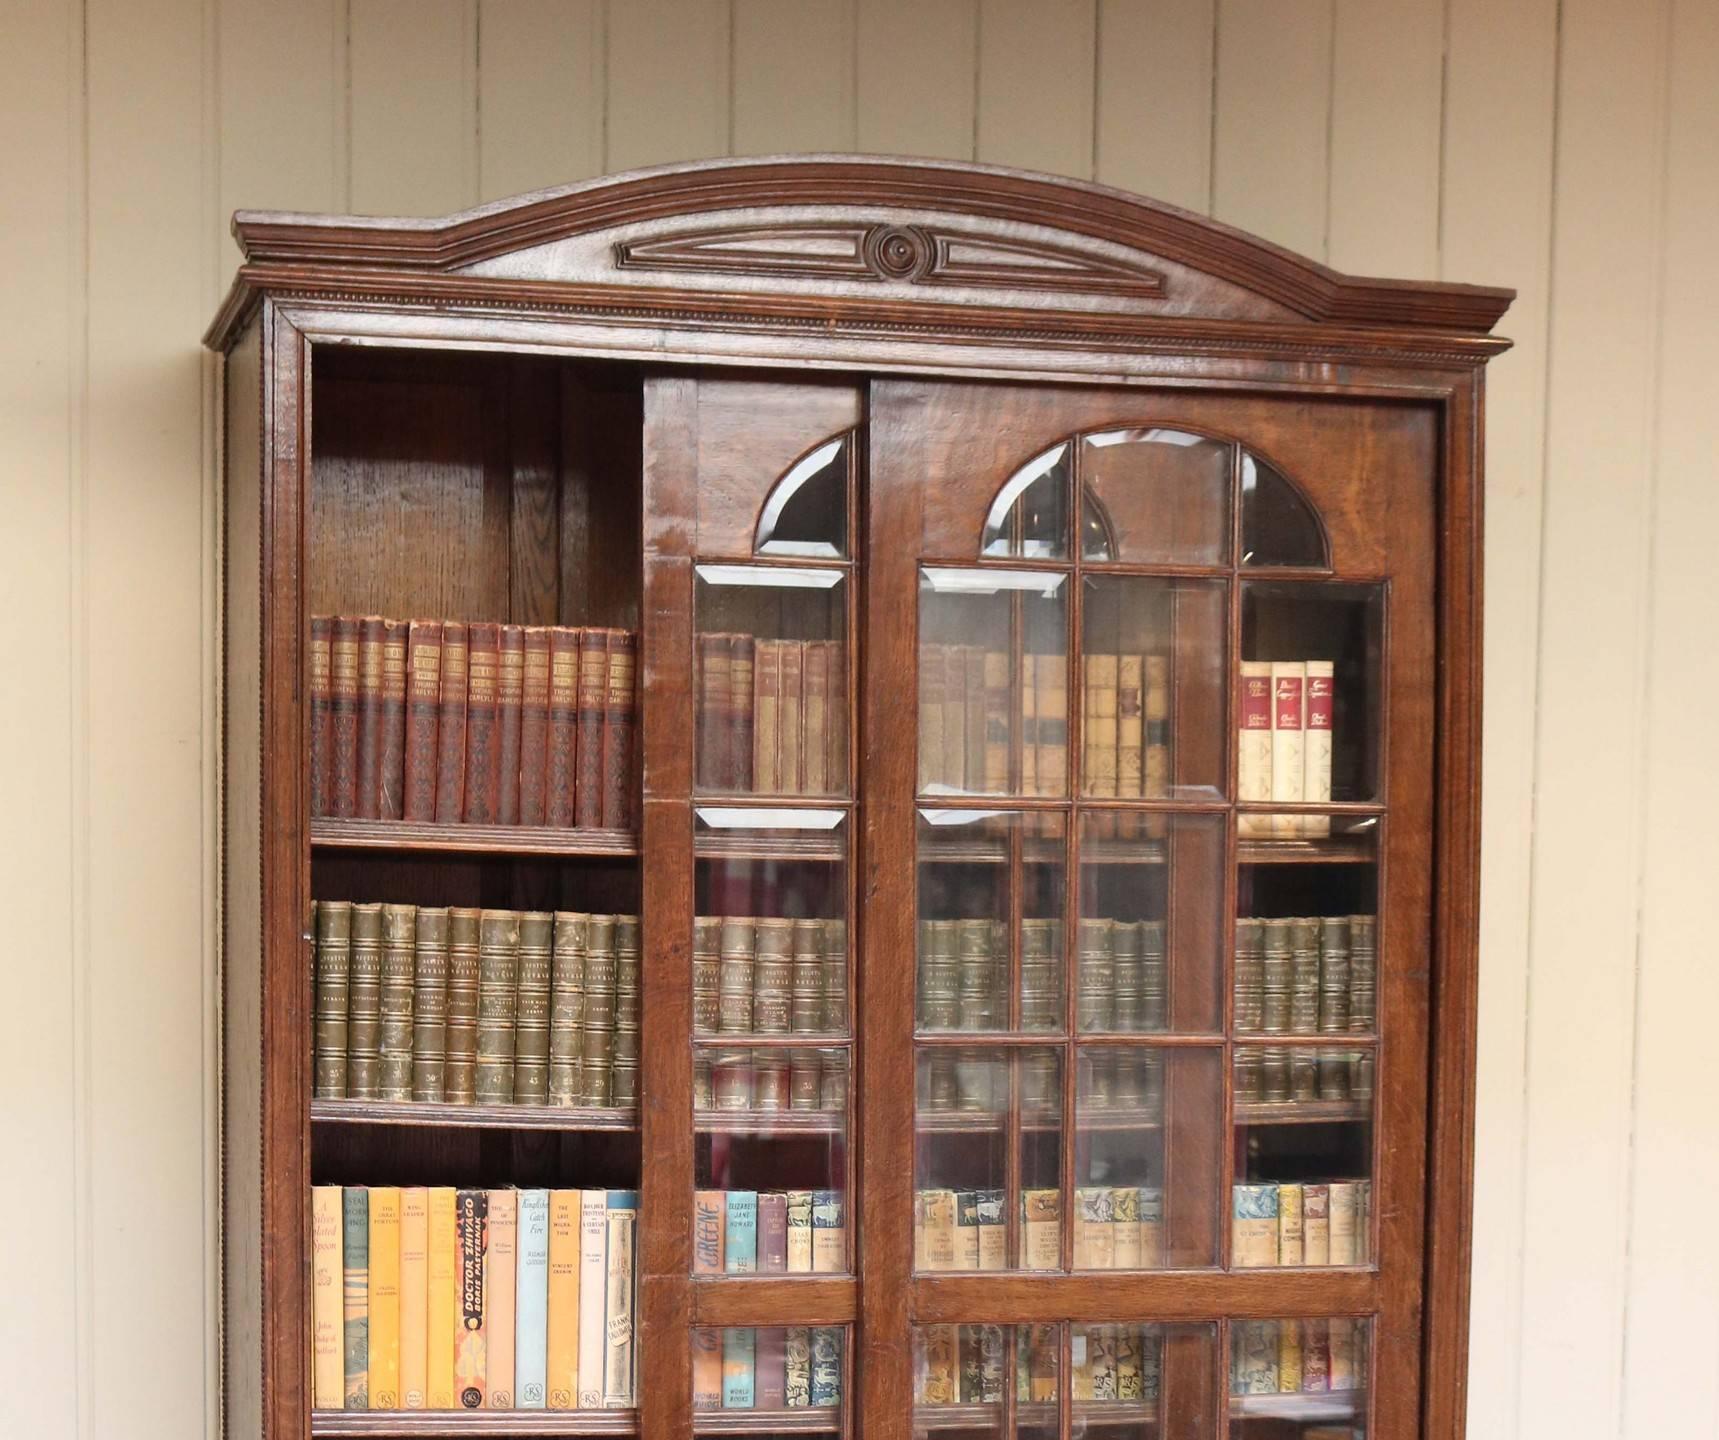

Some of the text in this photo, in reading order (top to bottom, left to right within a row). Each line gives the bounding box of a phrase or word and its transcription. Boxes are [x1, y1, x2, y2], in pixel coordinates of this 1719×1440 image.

[464, 1197, 476, 1312] DOCTOR ZHIVAGO
[529, 1223, 544, 1235] Fire
[474, 1216, 483, 1313] BORIS PASTERNAK
[608, 1315, 630, 1330] FRANK
